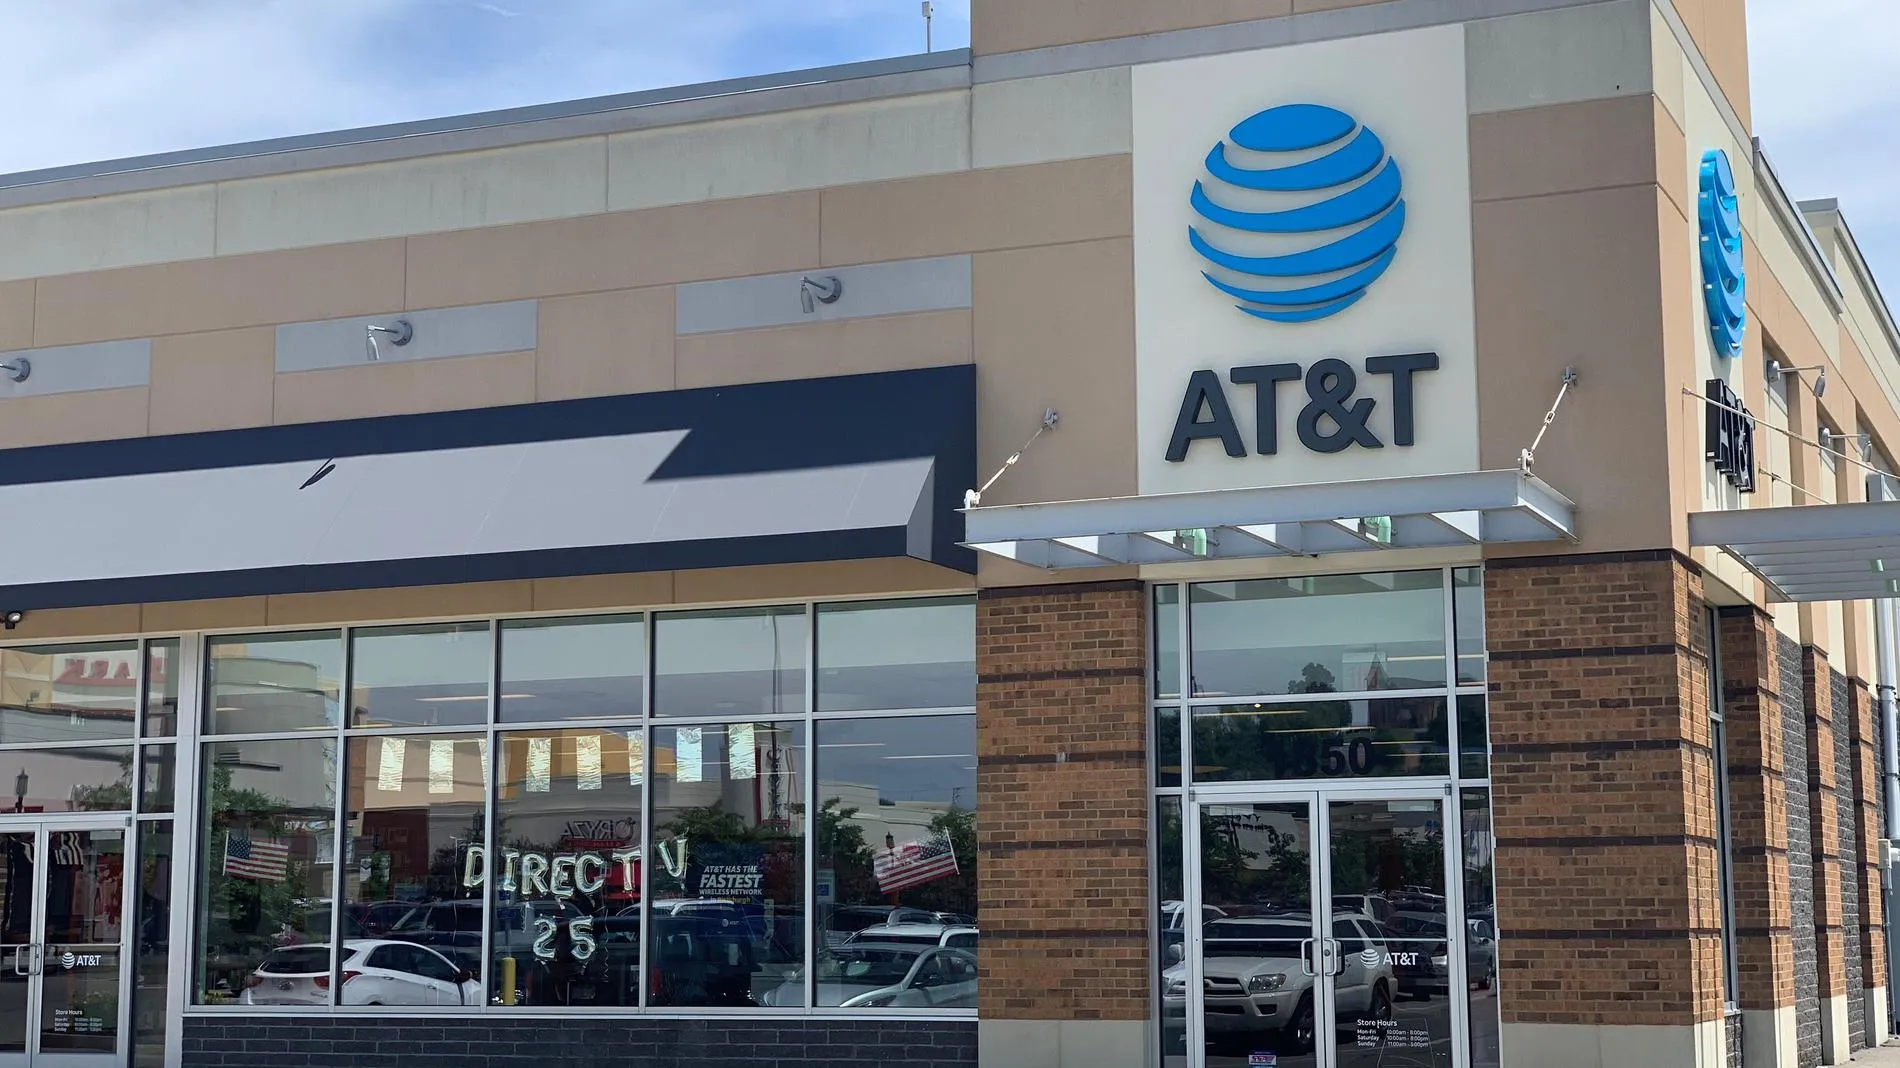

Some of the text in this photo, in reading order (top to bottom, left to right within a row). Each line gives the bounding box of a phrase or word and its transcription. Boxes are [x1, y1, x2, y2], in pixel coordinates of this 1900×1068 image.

[1165, 352, 1439, 462] AT&T
[704, 865, 758, 873] AT&T HAS THE
[700, 874, 763, 888] FASTEST
[533, 916, 596, 961] 25
[76, 955, 101, 966] AT&T
[1382, 952, 1418, 965] AT&T
[1357, 1019, 1398, 1027] Store Hours
